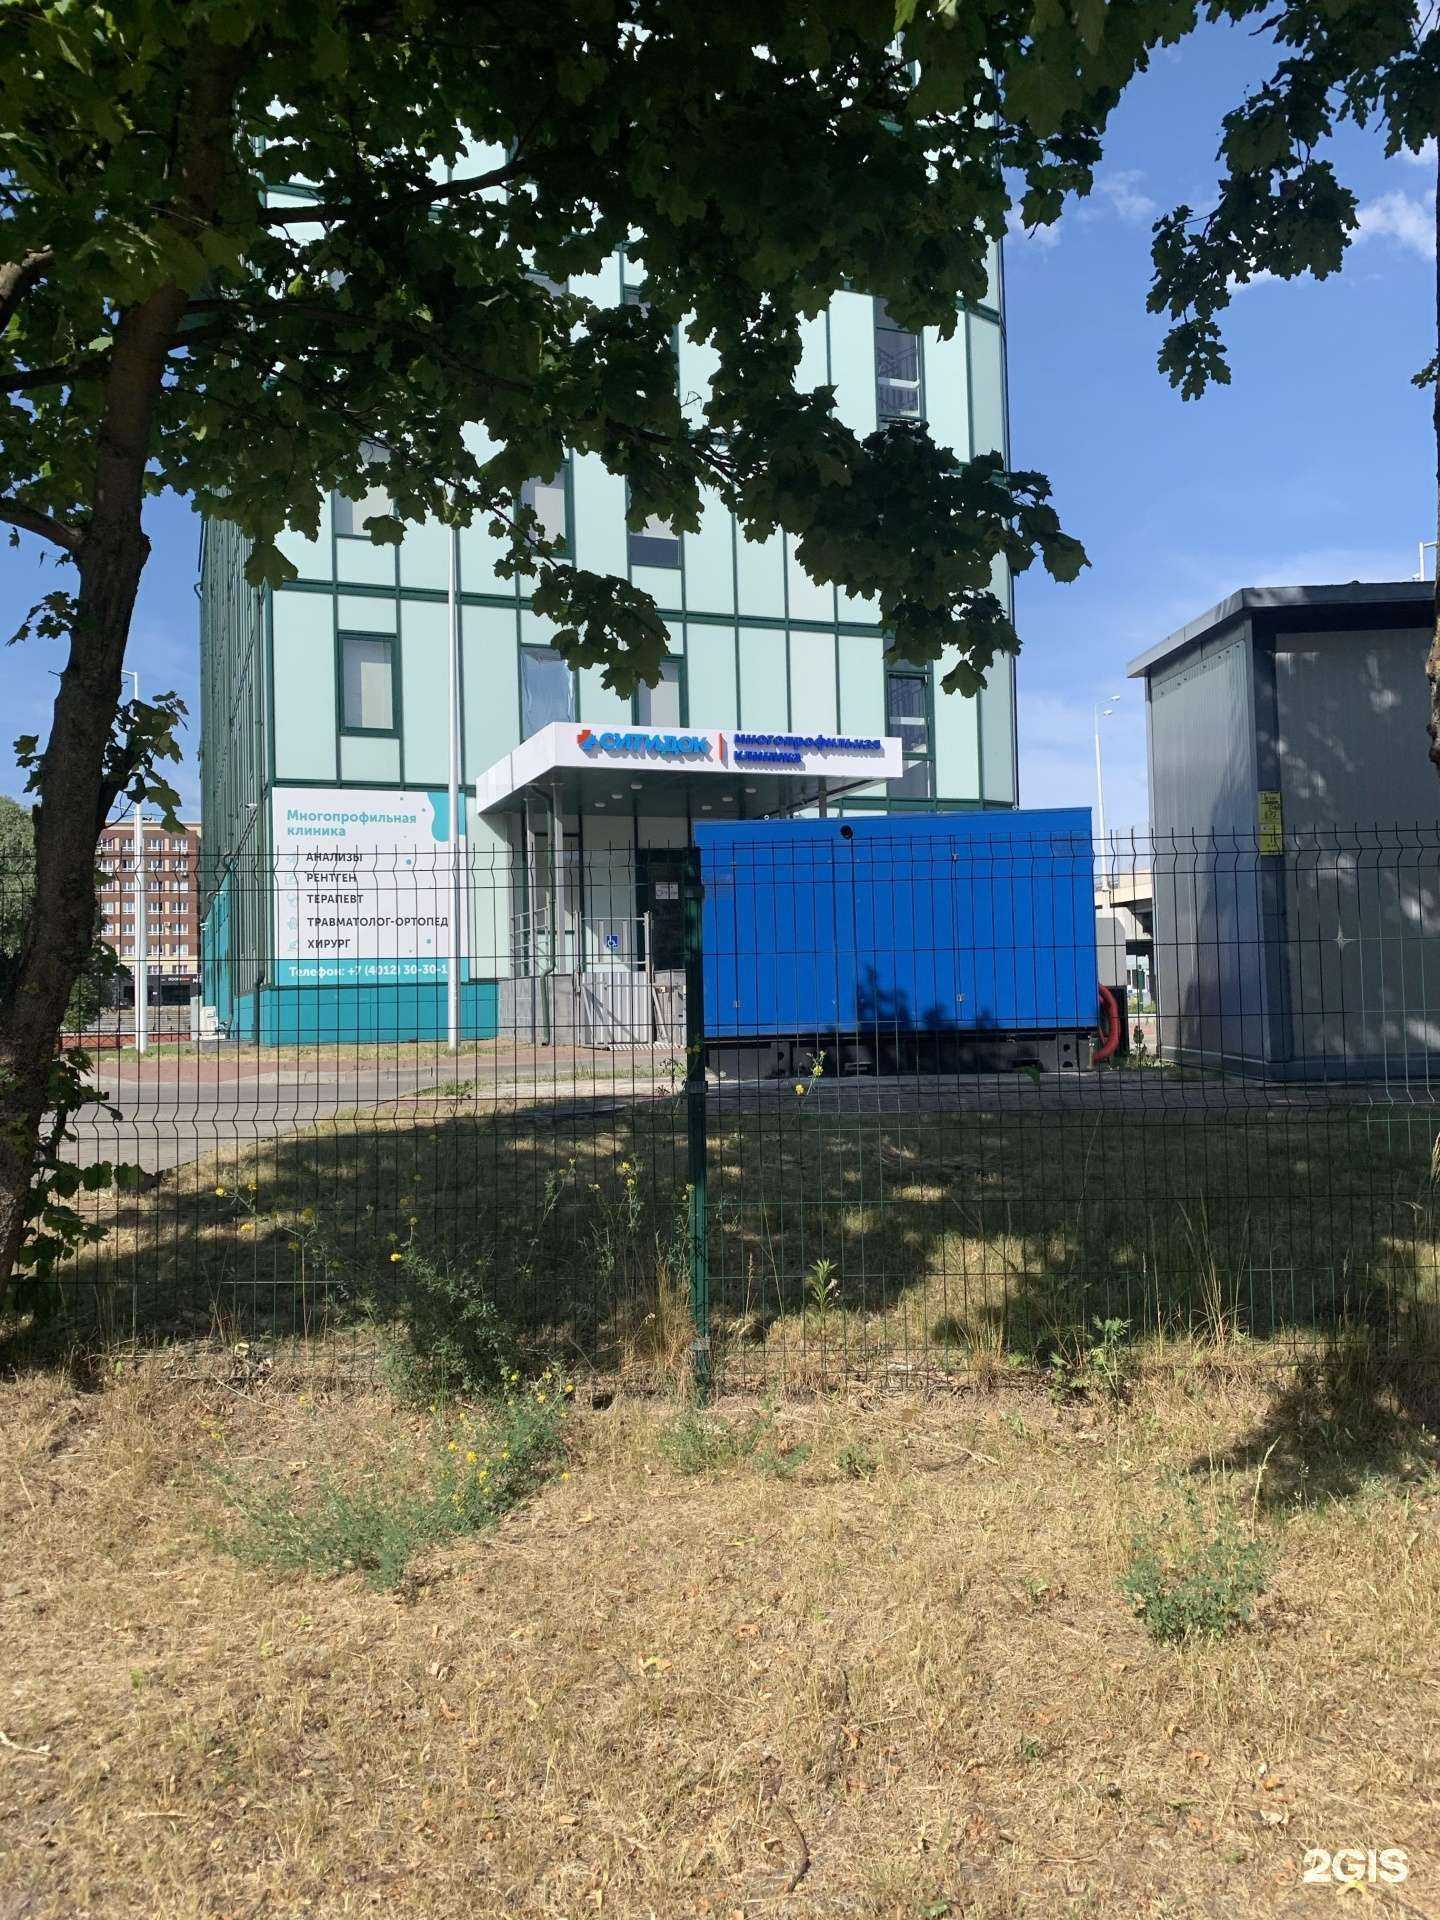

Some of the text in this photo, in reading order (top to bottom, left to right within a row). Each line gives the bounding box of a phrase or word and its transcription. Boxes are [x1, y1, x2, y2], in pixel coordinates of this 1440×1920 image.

[287, 809, 417, 825] Многопрофильная
[287, 827, 346, 837] клиника
[305, 852, 363, 863] АНАЛИЗЫ
[306, 873, 357, 883] РЕНТГЕН
[306, 894, 364, 904] ТЕРАПЕВТ
[306, 917, 449, 928] ТРАВМАТОЛОГ-ОРТОПЕД
[307, 939, 351, 949] ХИРУРГ
[403, 964, 449, 975] 30-30-1
